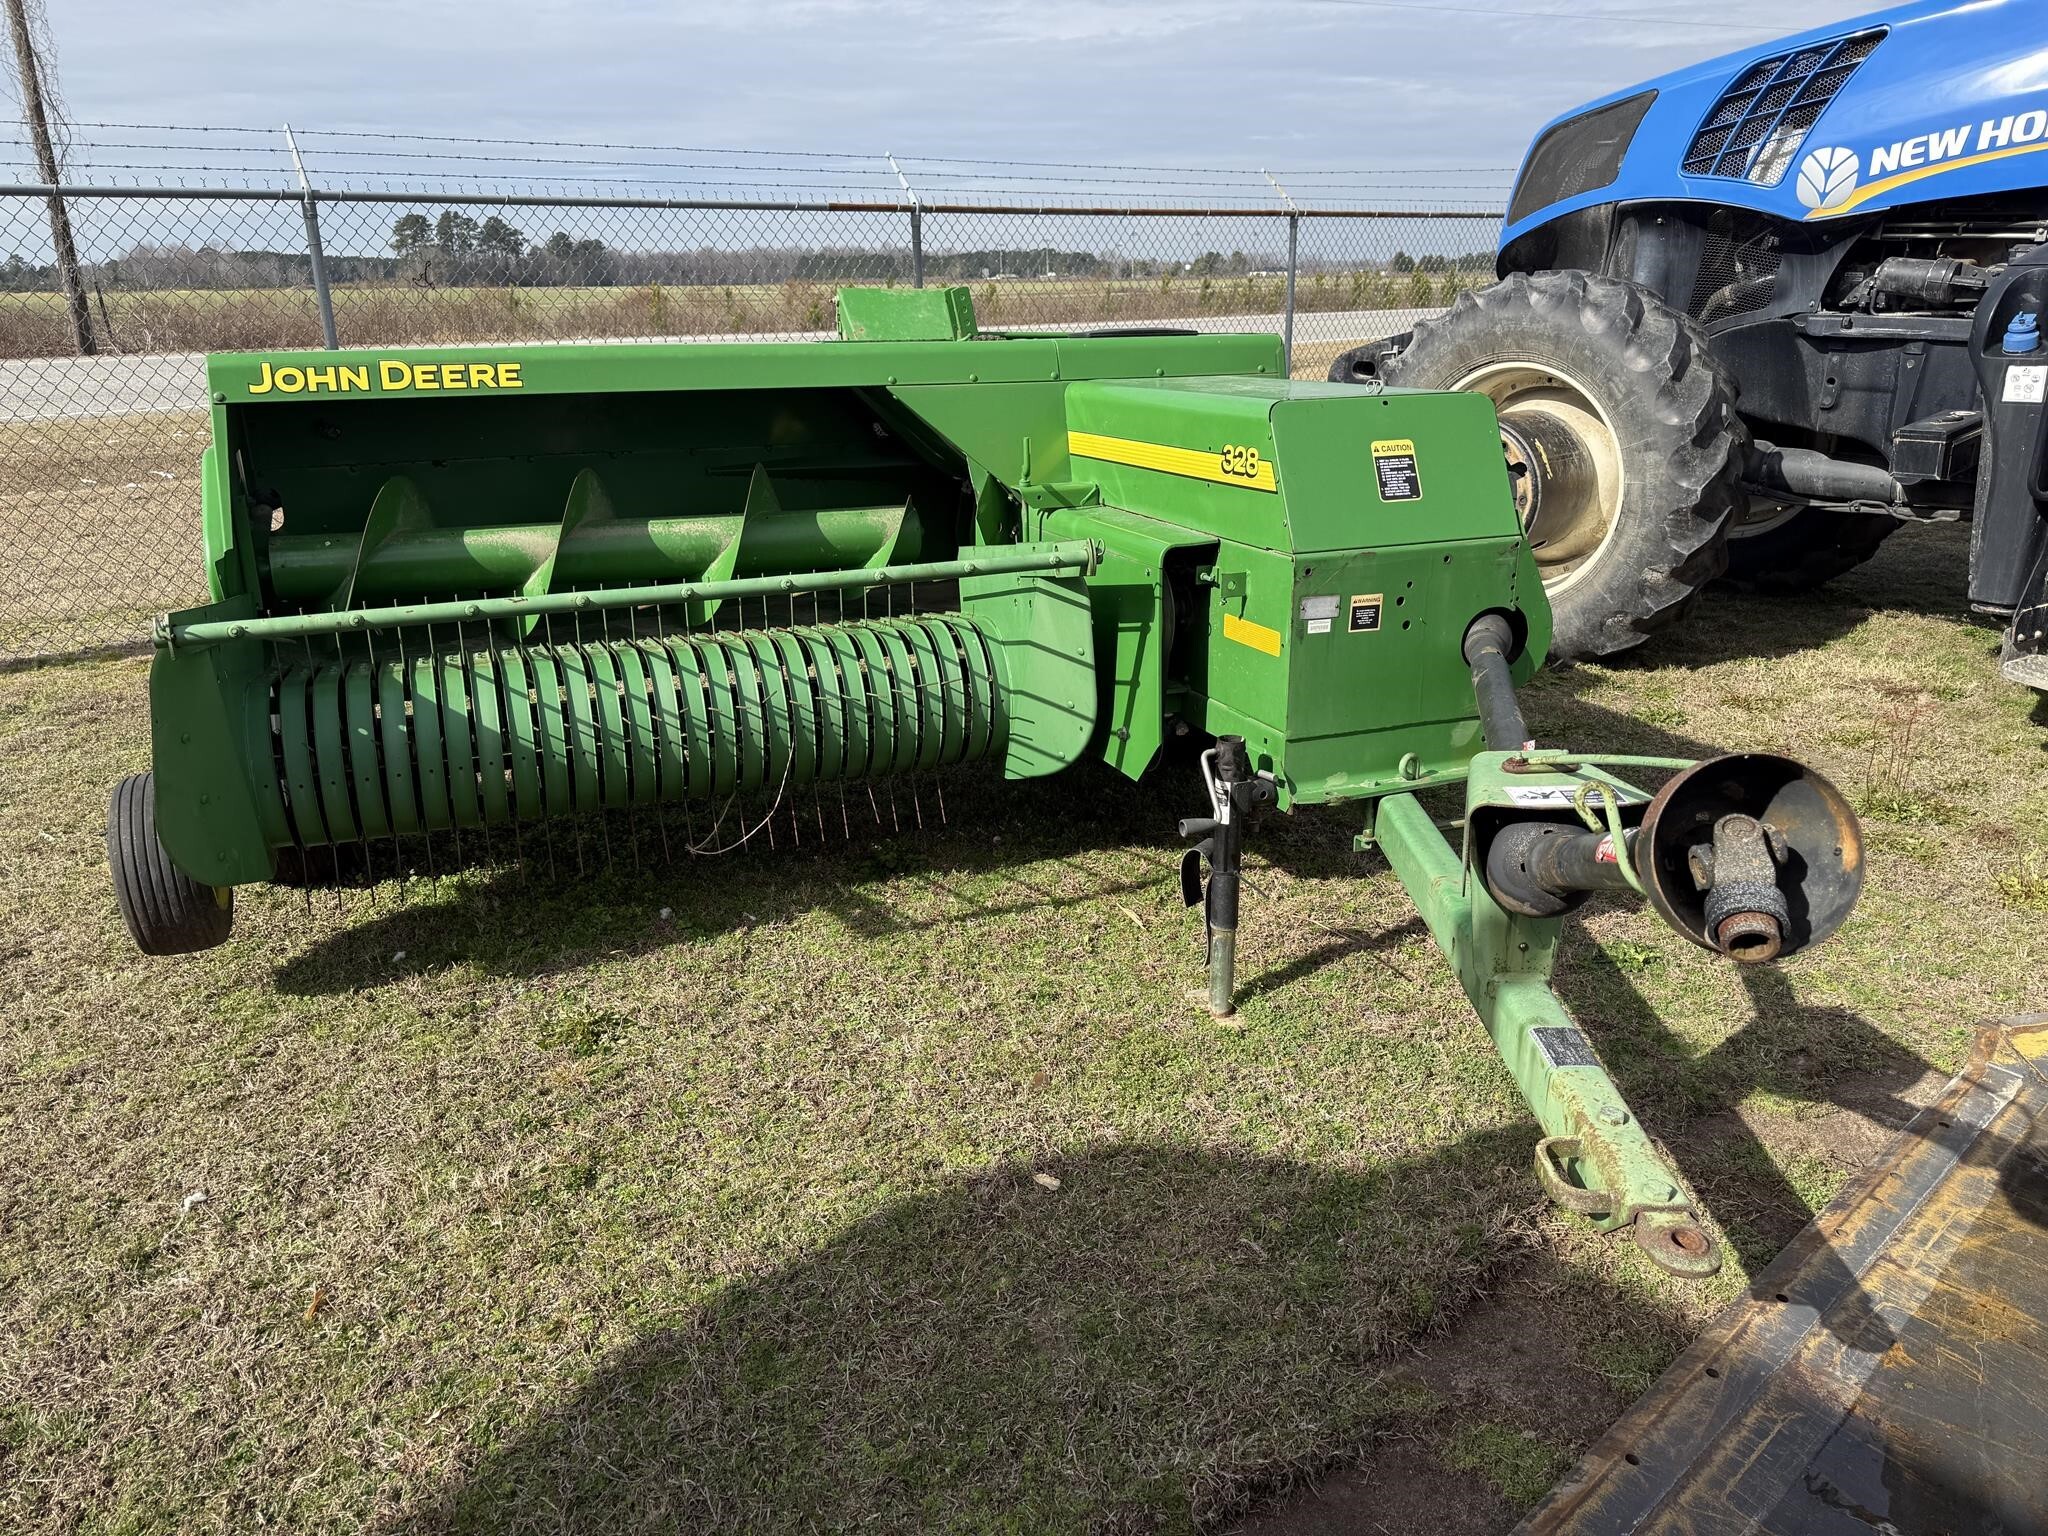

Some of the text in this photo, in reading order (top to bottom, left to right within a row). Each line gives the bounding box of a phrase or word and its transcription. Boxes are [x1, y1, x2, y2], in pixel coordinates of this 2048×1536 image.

[1868, 110, 2048, 176] NEW HO
[249, 359, 524, 394] JOHN DEERE
[1222, 444, 1259, 478] 328
[1381, 444, 1412, 452] CAUTION
